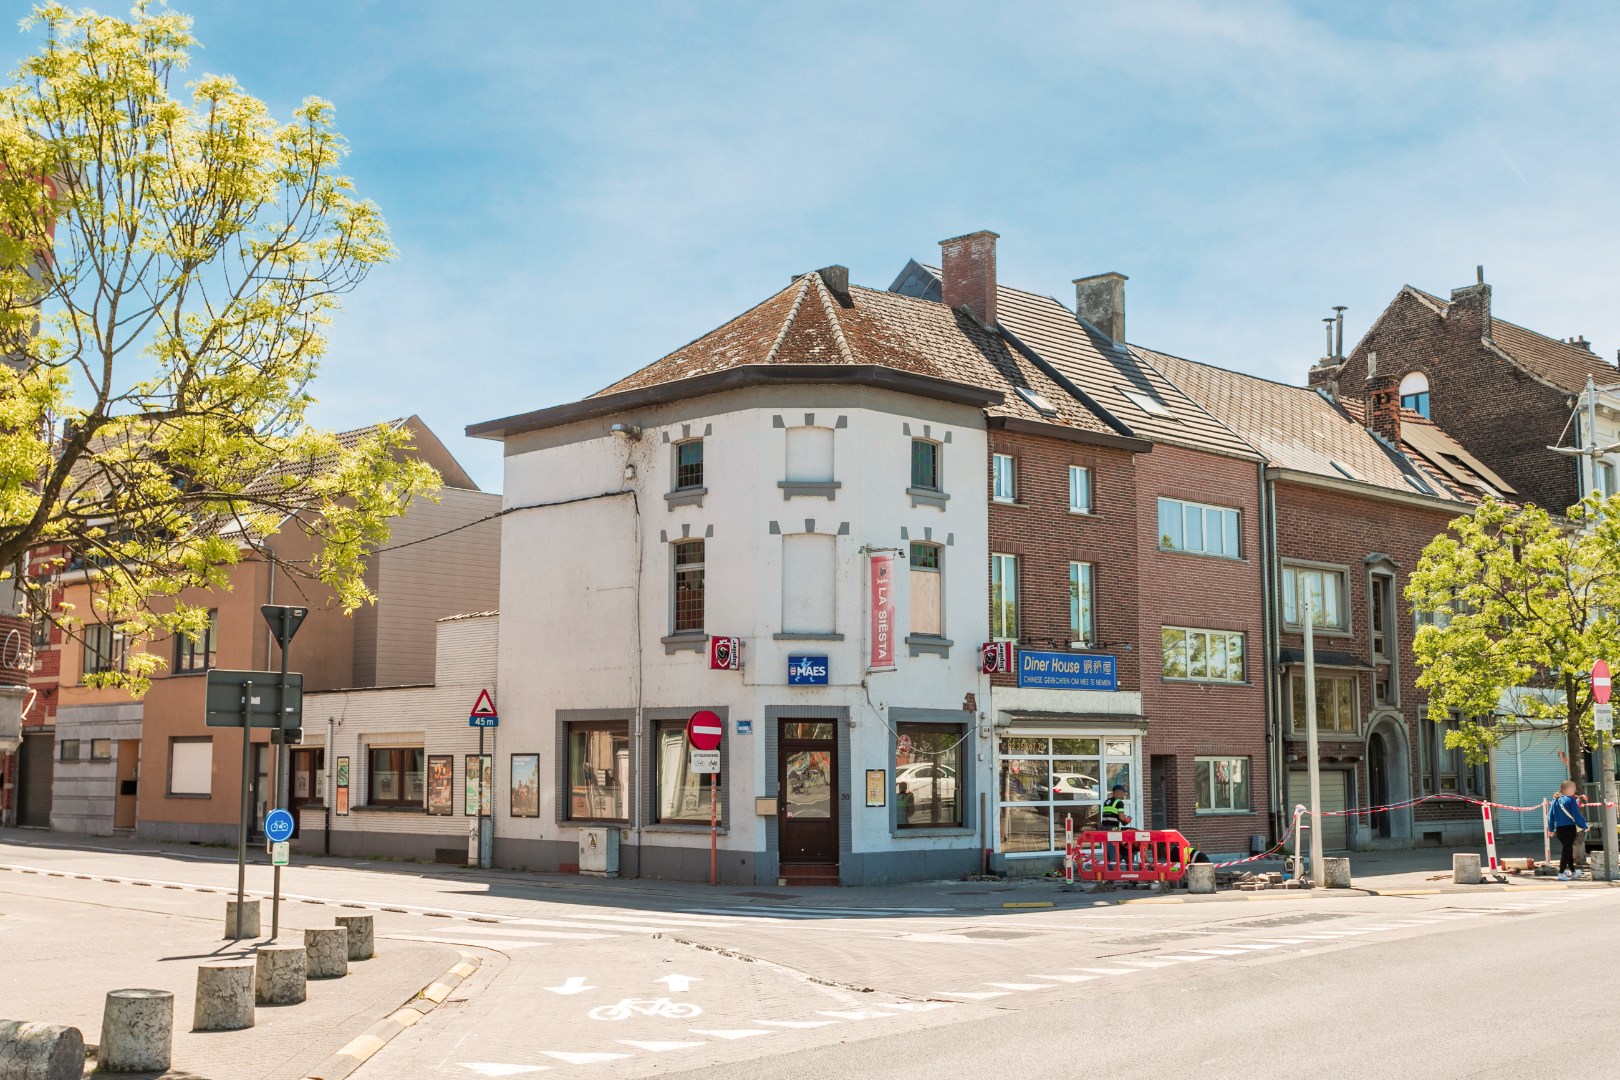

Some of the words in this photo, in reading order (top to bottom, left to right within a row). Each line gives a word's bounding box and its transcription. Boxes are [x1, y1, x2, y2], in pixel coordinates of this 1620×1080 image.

[878, 588, 887, 606] LA
[878, 610, 889, 659] SIËSTA
[1024, 656, 1050, 671] Diner
[1052, 658, 1080, 673] House
[796, 666, 826, 677] MAES
[1024, 676, 1042, 684] CHINESE
[1043, 676, 1070, 685] GERECHTEN
[1070, 677, 1080, 686] OM
[1080, 678, 1089, 686] MEE
[474, 717, 486, 726] 45
[841, 793, 850, 801] 30
